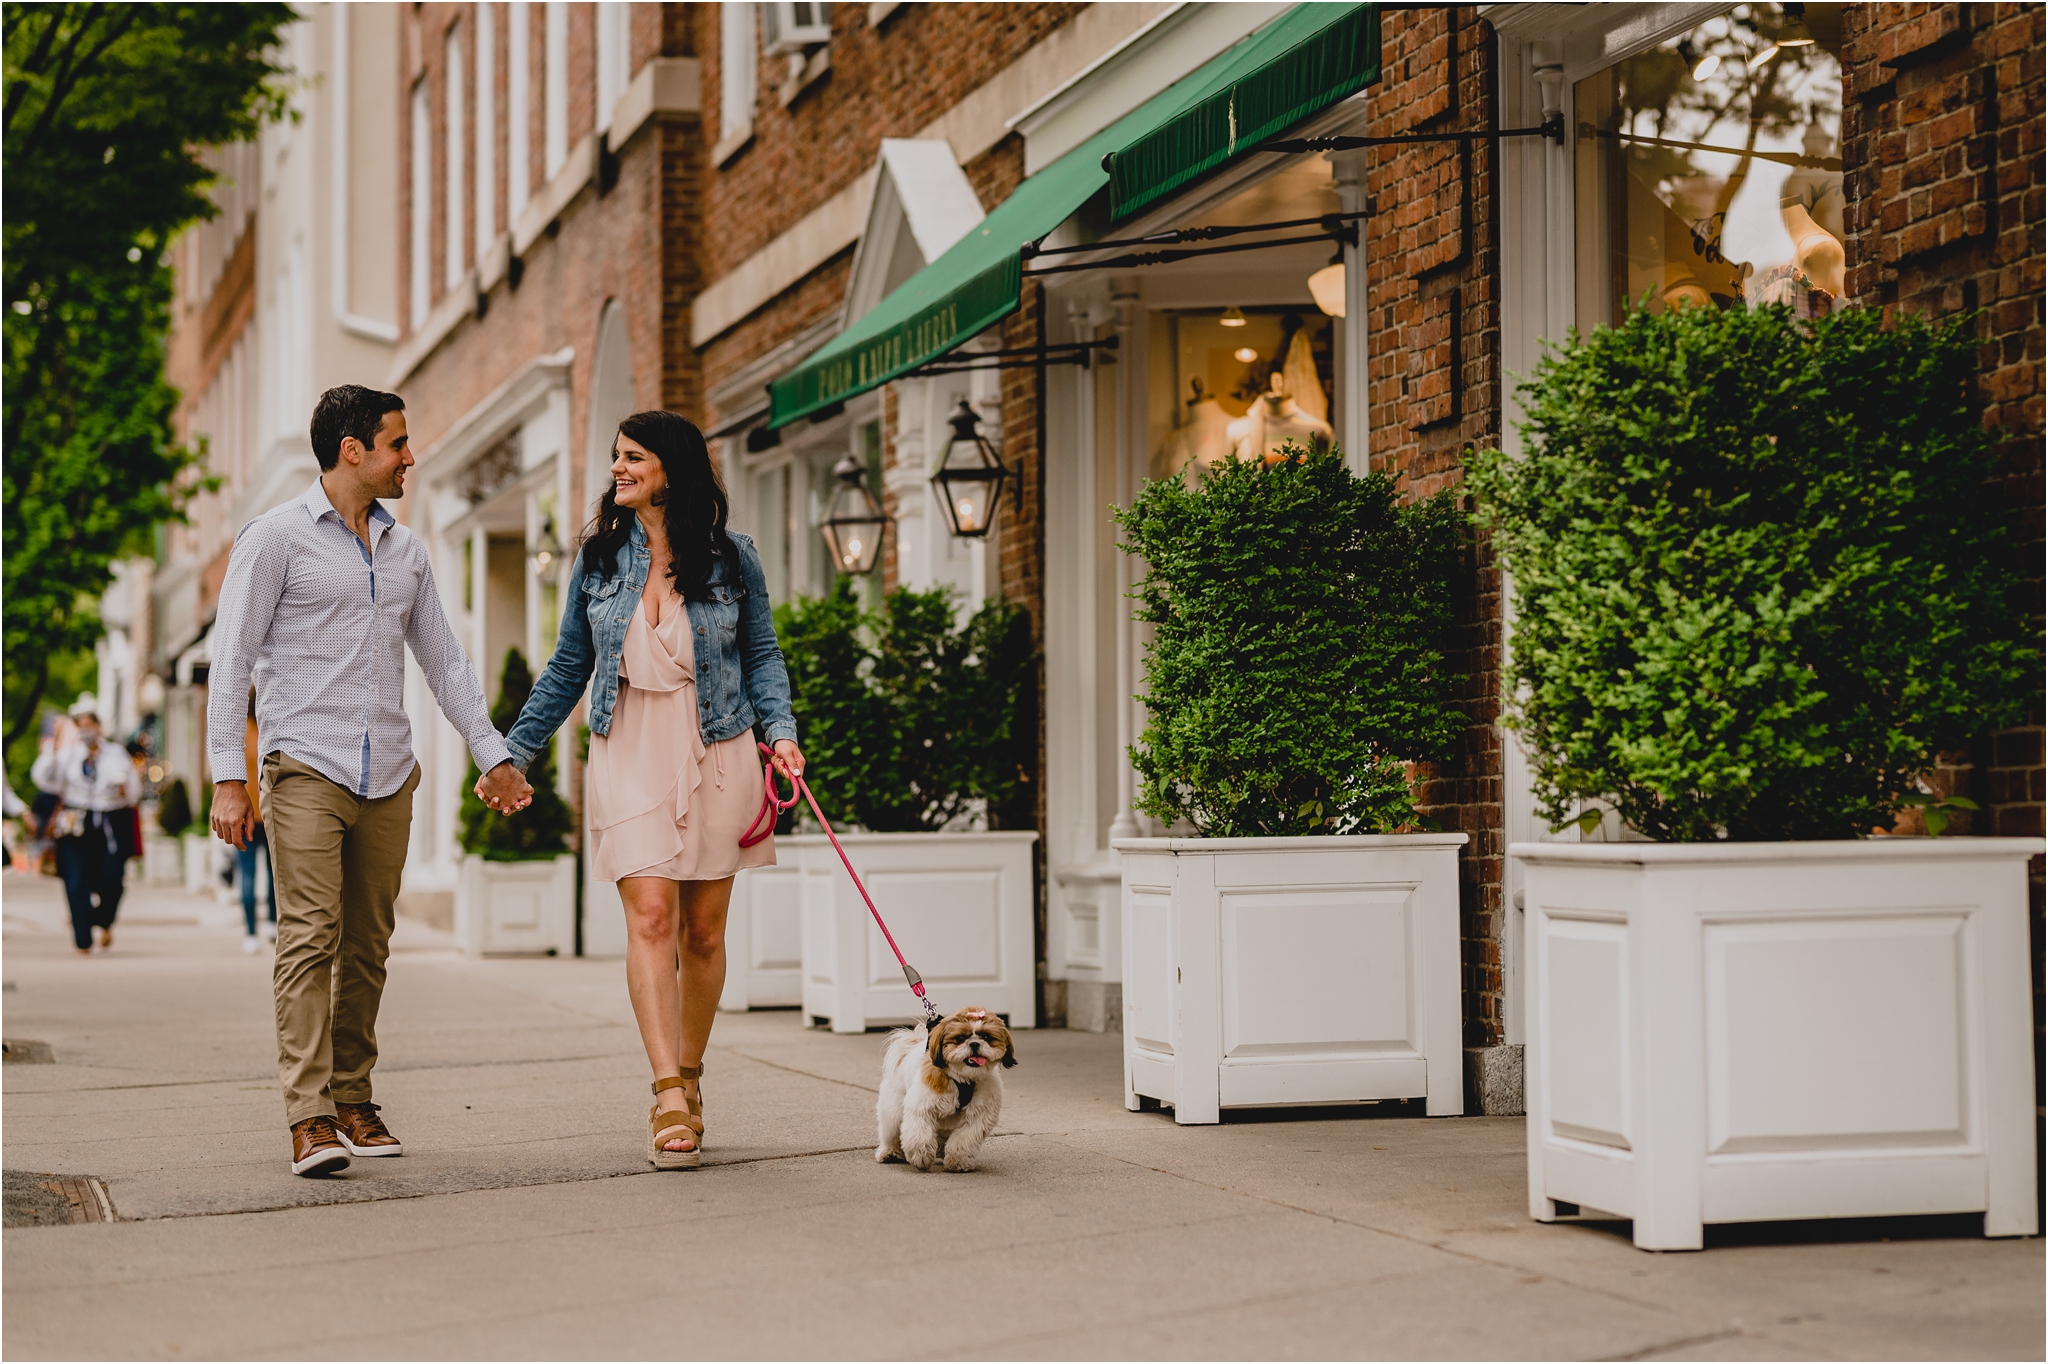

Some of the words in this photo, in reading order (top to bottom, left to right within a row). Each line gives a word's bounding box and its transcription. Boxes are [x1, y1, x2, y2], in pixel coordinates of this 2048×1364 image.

[818, 359, 853, 402] POLO
[859, 336, 901, 386] RALPH
[907, 303, 958, 364] LAUREN
